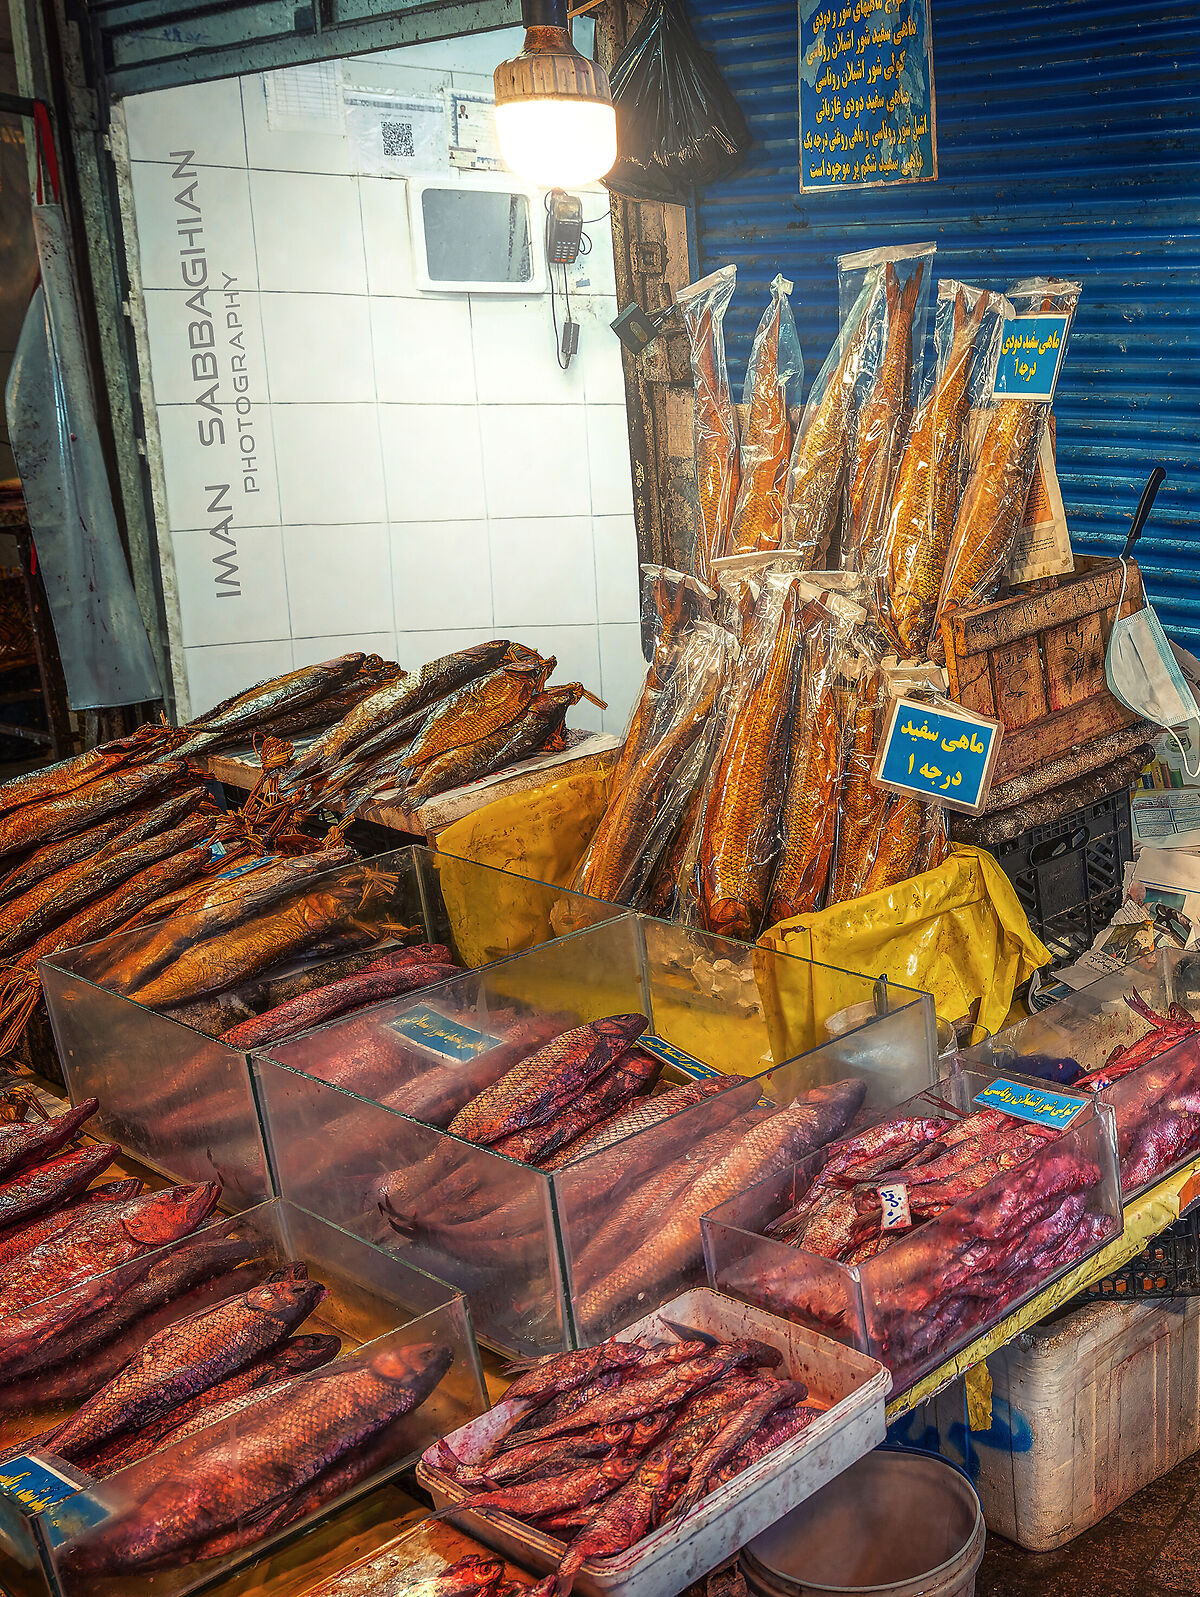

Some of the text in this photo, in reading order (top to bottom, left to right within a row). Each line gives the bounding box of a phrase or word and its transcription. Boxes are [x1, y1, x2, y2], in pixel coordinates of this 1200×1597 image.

[812, 9, 831, 34] دودی
[831, 11, 837, 30] و
[893, 15, 917, 45] ماهی
[855, 25, 871, 55] شور
[872, 22, 892, 48] سفید
[867, 55, 882, 85] شور
[843, 94, 864, 120] دودی
[866, 88, 884, 115] سفید
[886, 84, 909, 113] ماهی
[803, 129, 813, 154] یک
[814, 131, 828, 154] درجه
[849, 122, 864, 150] ماهی
[865, 129, 869, 148] و
[898, 115, 911, 145] شور
[809, 157, 825, 179] است
[826, 161, 851, 182] موجود
[861, 151, 877, 182] شکم
[878, 151, 899, 177] سفید
[901, 147, 924, 176] ماهی
[1002, 329, 1060, 355] ماهی سفید دودی
[1018, 361, 1037, 382] درجه
[901, 720, 984, 754] ماهی سفید
[919, 762, 963, 790] درجه
[1034, 1100, 1058, 1114] شور
[1050, 1102, 1081, 1119] کولی
